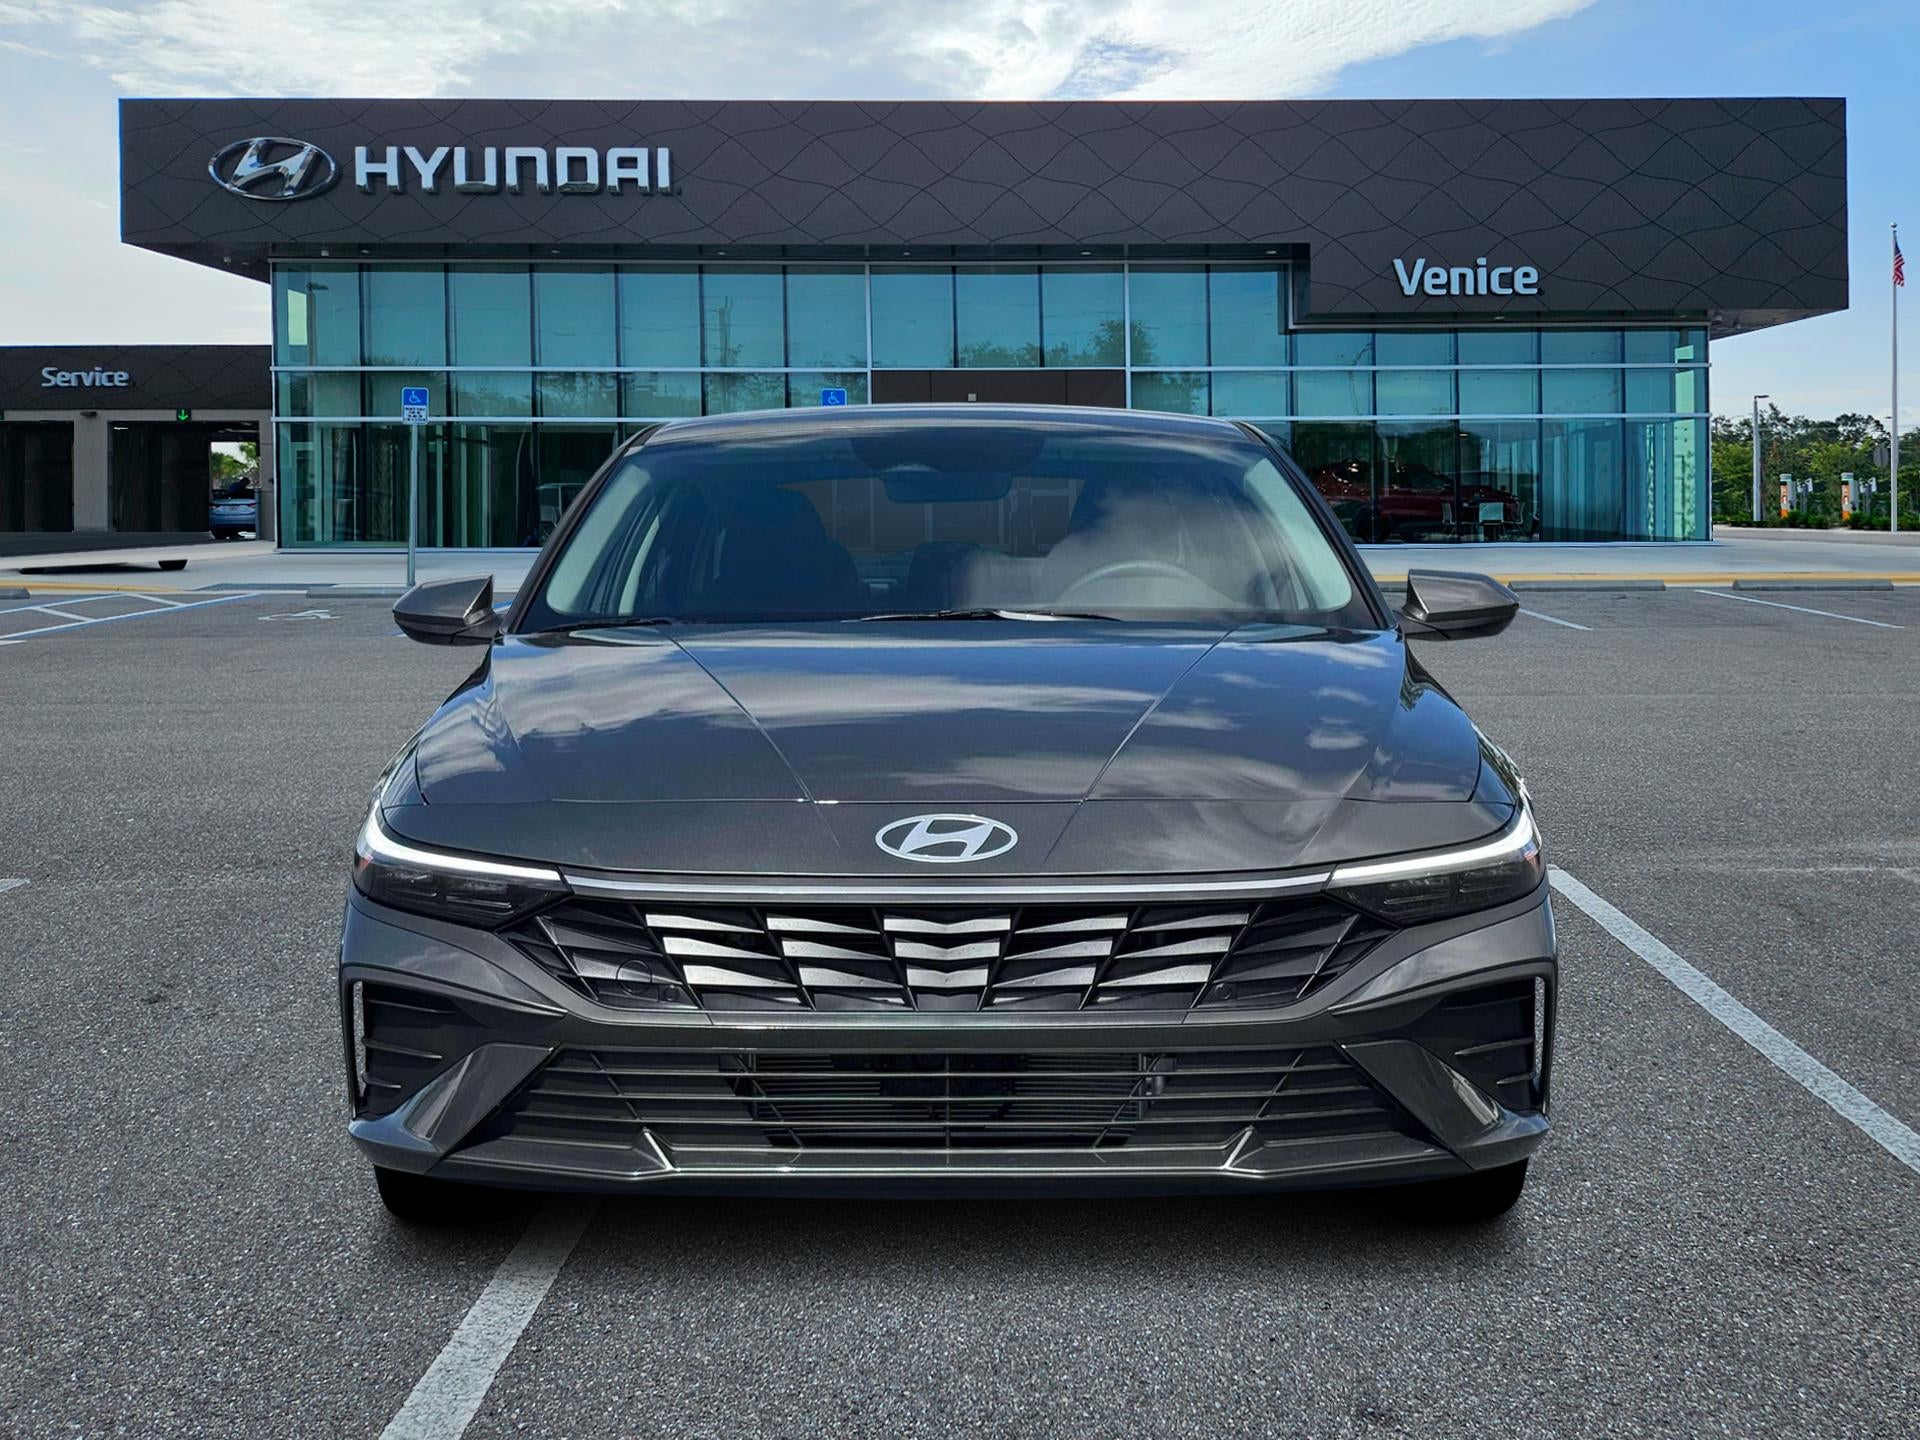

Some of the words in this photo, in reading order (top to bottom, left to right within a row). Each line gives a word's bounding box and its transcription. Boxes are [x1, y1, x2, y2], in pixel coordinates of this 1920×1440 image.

[354, 146, 671, 194] HYUNDAI
[1392, 256, 1540, 296] Venice
[41, 366, 130, 387] Service
